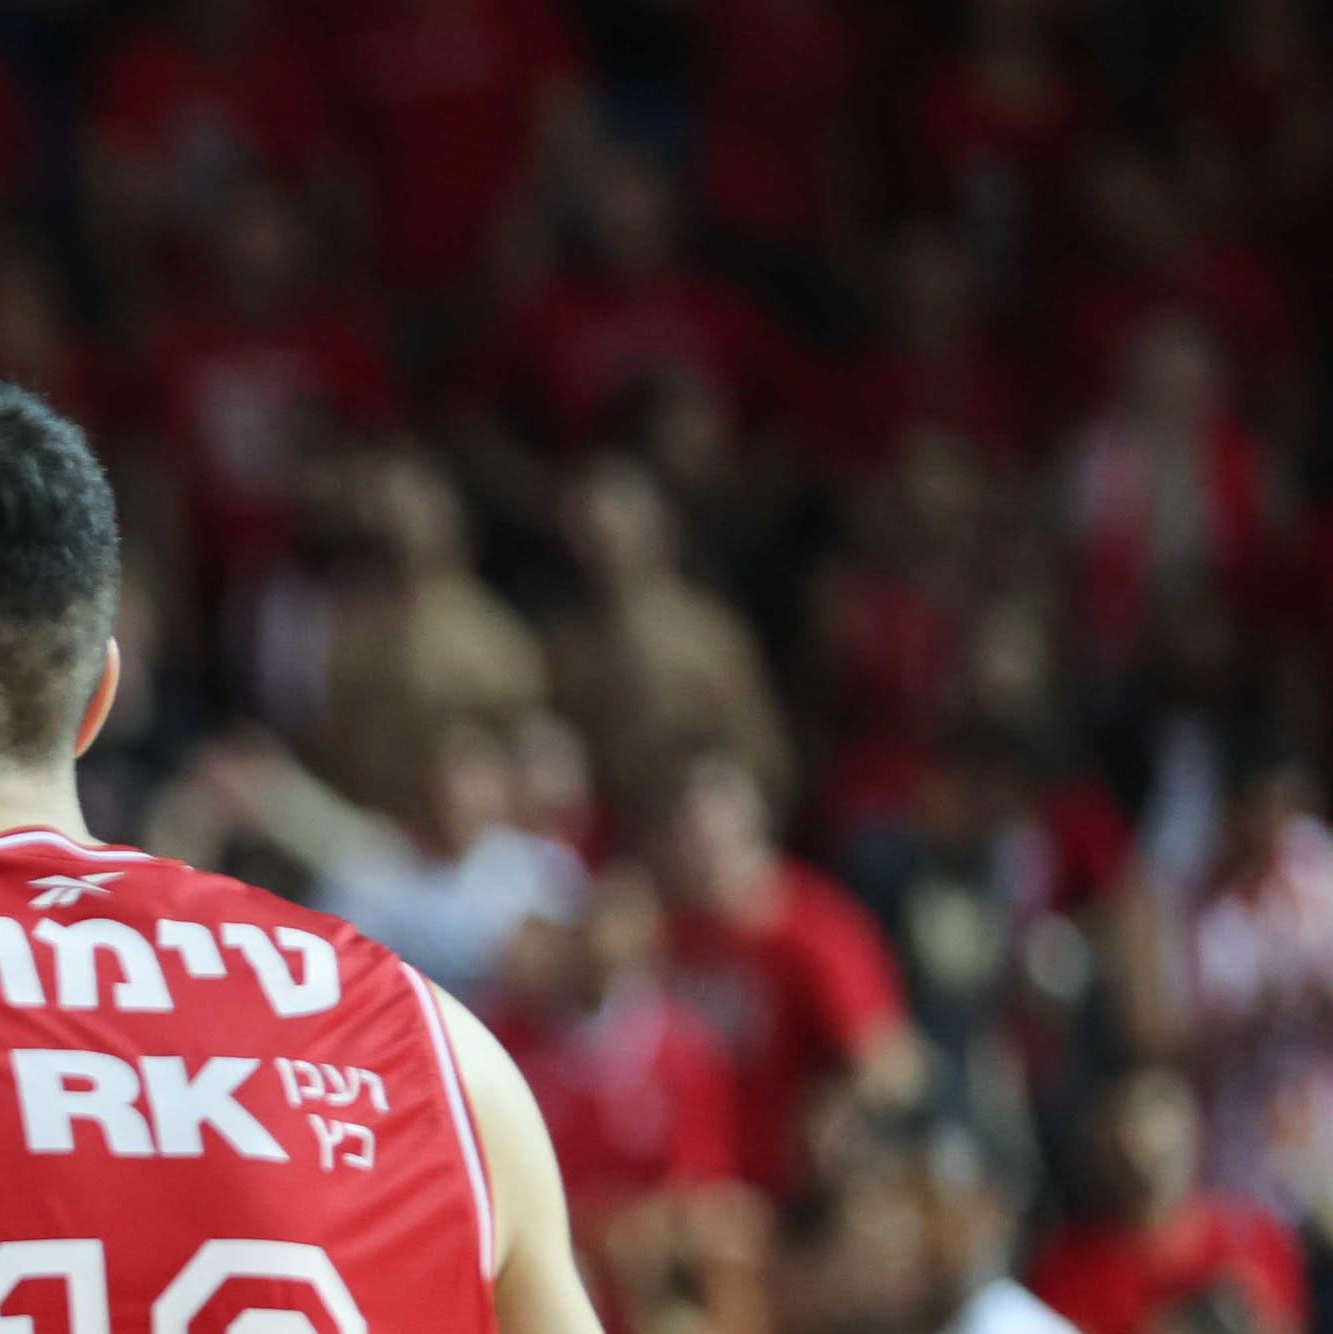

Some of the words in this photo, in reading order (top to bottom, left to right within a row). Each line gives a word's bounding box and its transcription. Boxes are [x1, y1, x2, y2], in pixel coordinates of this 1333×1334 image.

[10, 1048, 290, 1163] RK
[274, 1056, 390, 1113] רענן
[308, 1113, 377, 1171] כץ
